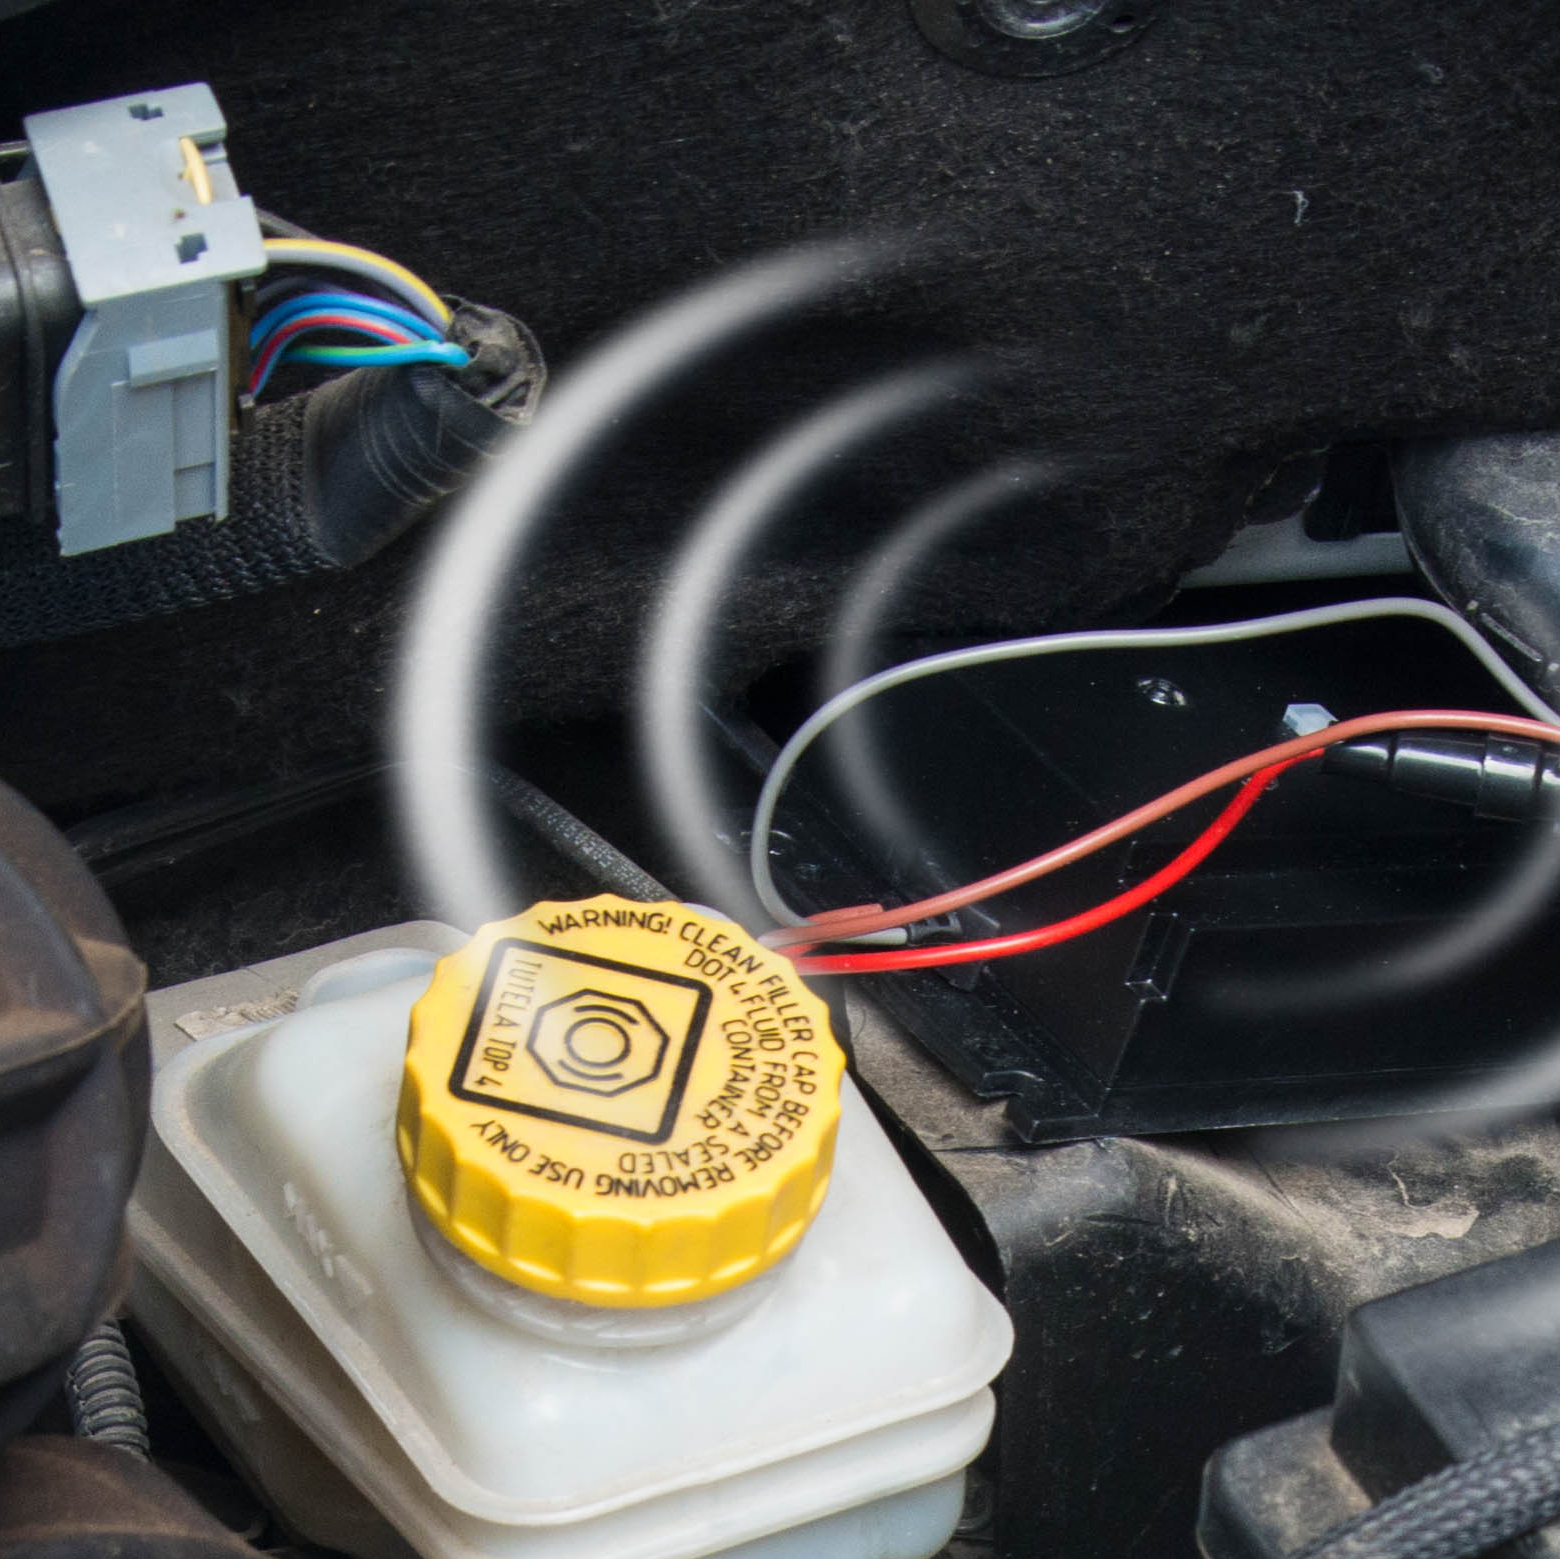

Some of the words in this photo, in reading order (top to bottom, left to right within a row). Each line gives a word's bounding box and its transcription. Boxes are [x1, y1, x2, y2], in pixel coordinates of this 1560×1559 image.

[537, 908, 673, 936] WARNING!
[679, 921, 764, 975] CLEAN
[683, 948, 736, 982] DOT
[492, 959, 542, 1028] TUTELA
[729, 981, 747, 995] 4
[758, 974, 814, 1041] FILLER
[740, 994, 785, 1052] FLUID
[483, 1038, 518, 1072] TOP
[694, 1018, 756, 1130] CONTAINER
[792, 1051, 819, 1095] CAP
[474, 1075, 503, 1088] 4
[746, 1061, 787, 1119] FROM
[470, 1119, 531, 1163] ONLY
[727, 1121, 751, 1137] A
[733, 1100, 810, 1172] BEFORE
[527, 1154, 585, 1190] USE
[618, 1135, 730, 1174] SEALED
[595, 1162, 735, 1199] REMOVING
